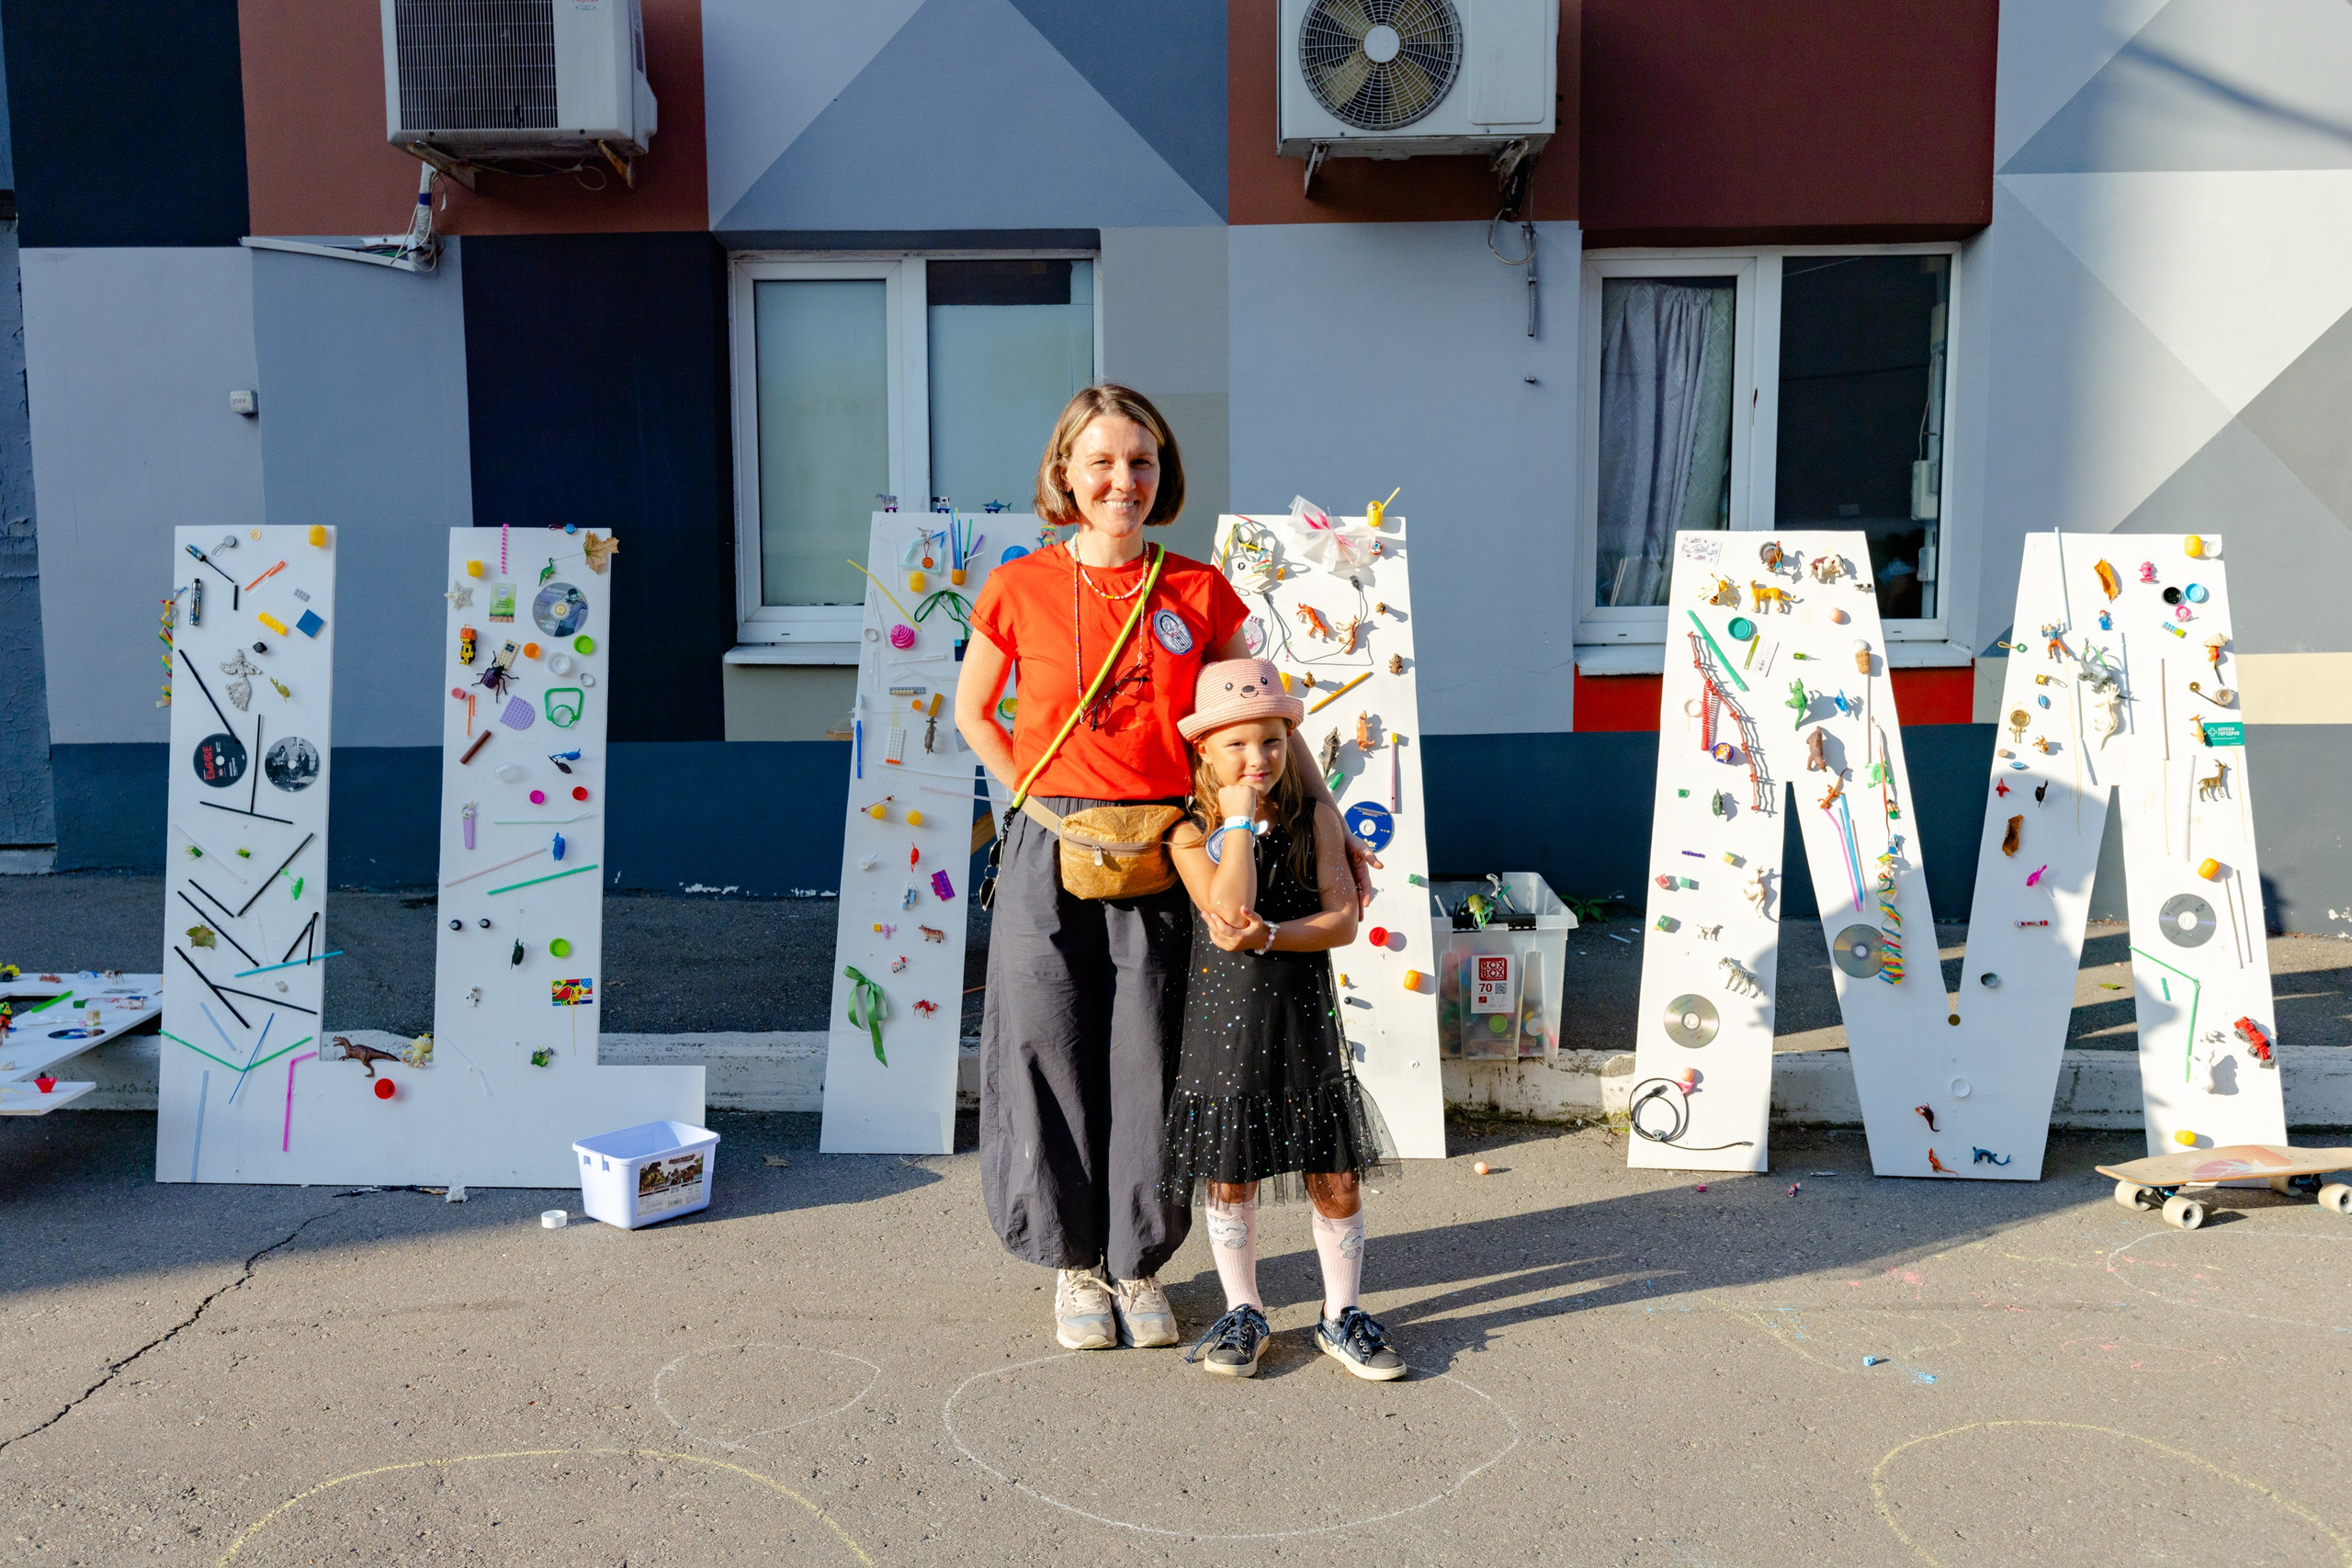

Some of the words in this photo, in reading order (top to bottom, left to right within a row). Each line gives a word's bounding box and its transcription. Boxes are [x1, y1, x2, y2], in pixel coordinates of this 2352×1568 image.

[202, 745, 215, 780] EMPIRE
[1480, 961, 1505, 970] ROX
[1480, 969, 1505, 978] BOX
[1478, 983, 1493, 992] 70
